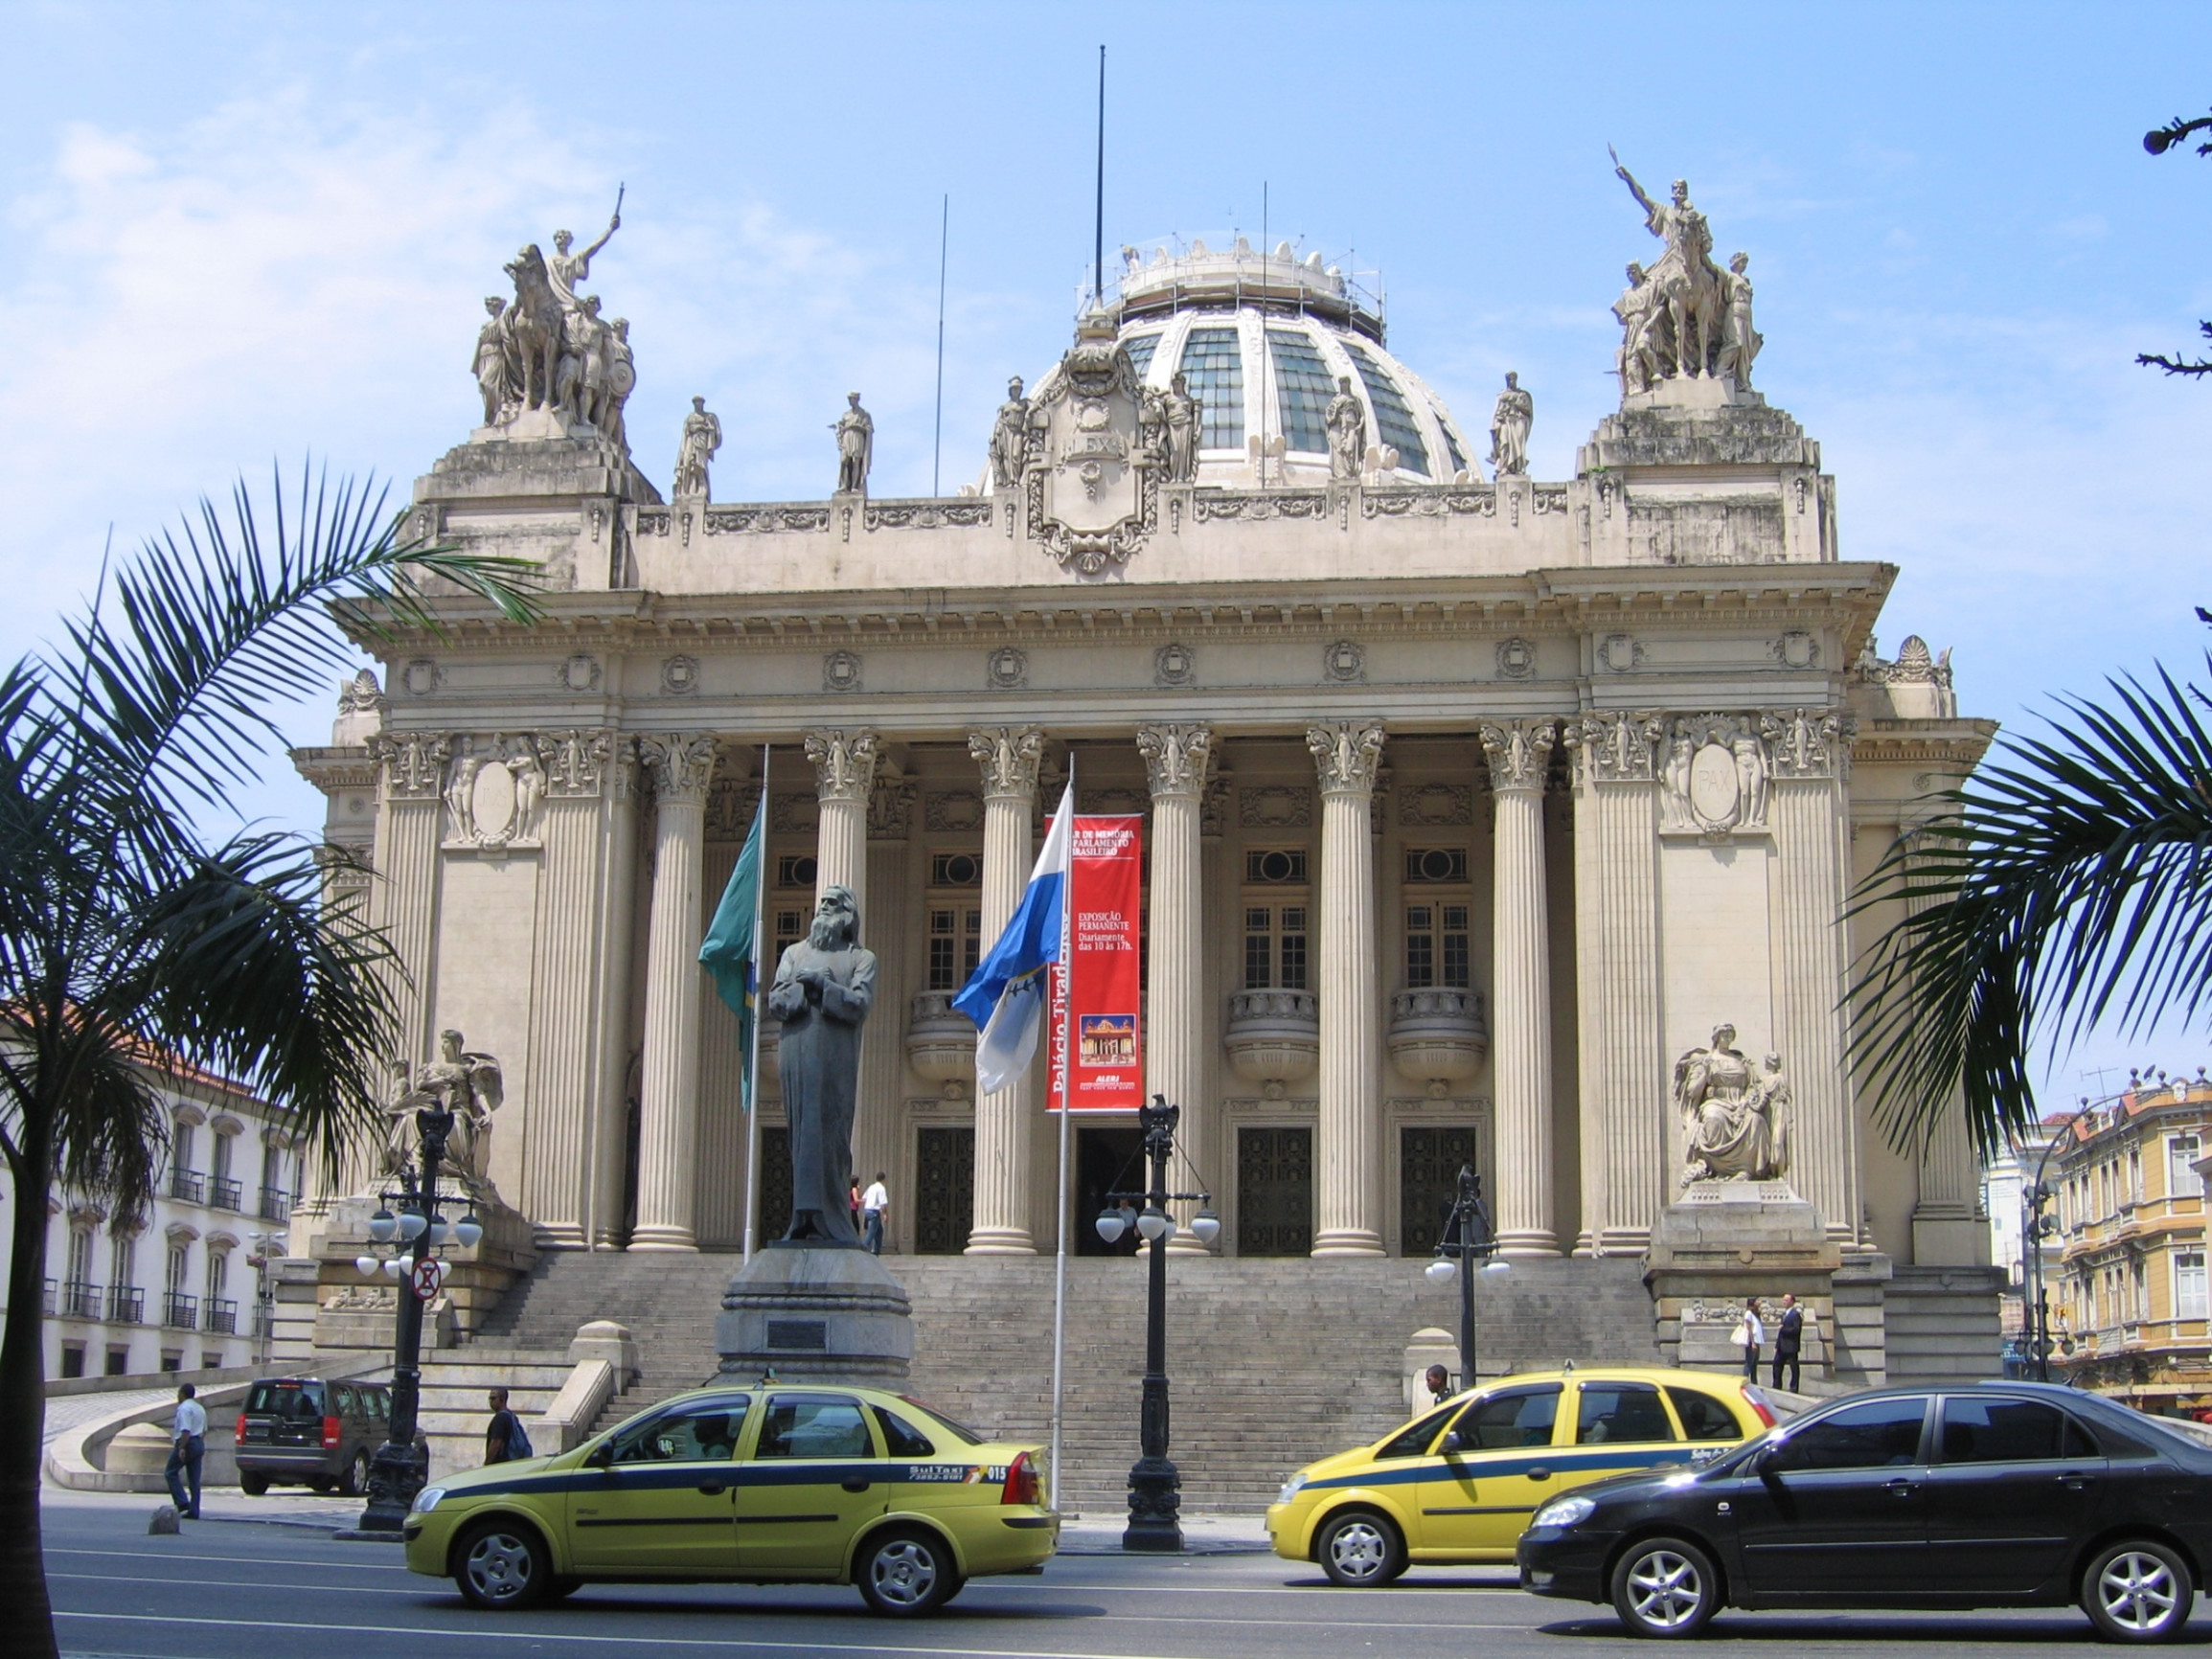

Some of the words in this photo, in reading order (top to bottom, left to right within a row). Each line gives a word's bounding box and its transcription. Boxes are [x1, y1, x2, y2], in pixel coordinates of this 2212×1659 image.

[1083, 830, 1094, 839] DE
[1095, 829, 1135, 839] MEMÓRIA
[1073, 839, 1129, 848] PARLAMENTO
[1073, 847, 1118, 856] BRASILEIRO
[1079, 911, 1122, 922] EXPOSIÇÃO
[1079, 920, 1129, 931] PERMANENTE
[1079, 933, 1126, 942] Diariamente
[1079, 942, 1092, 950] das
[1095, 942, 1104, 950] 10
[988, 1466, 1007, 1481] 015
